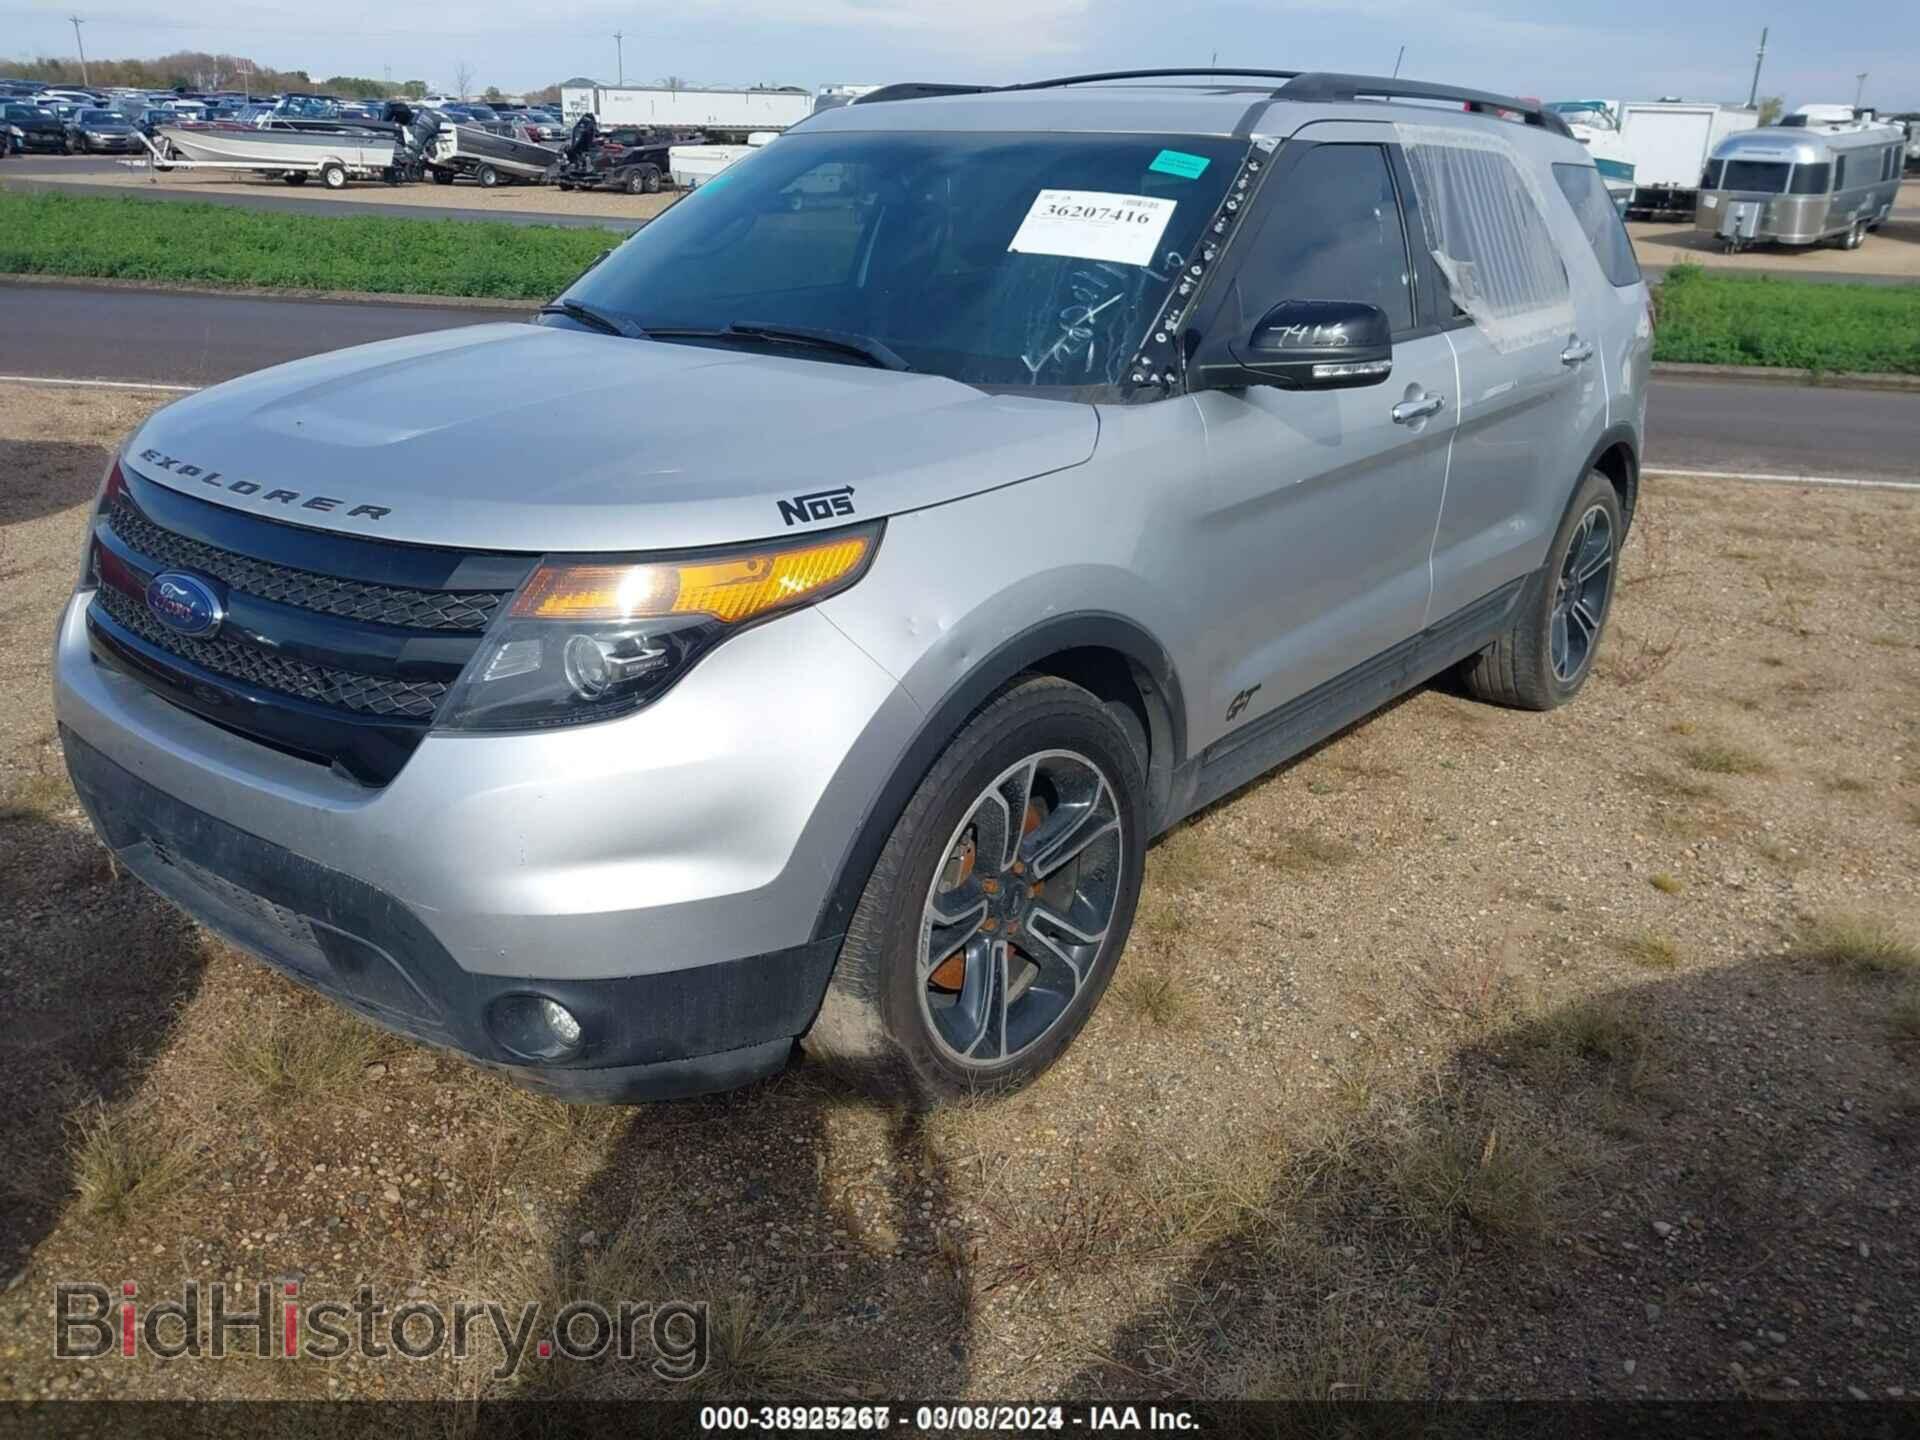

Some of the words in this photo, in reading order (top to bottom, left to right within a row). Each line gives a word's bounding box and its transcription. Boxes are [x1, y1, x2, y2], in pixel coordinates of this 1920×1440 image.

[1042, 204, 1150, 225] 36207416
[139, 448, 392, 521] EXPLORER
[776, 486, 855, 527] NOS
